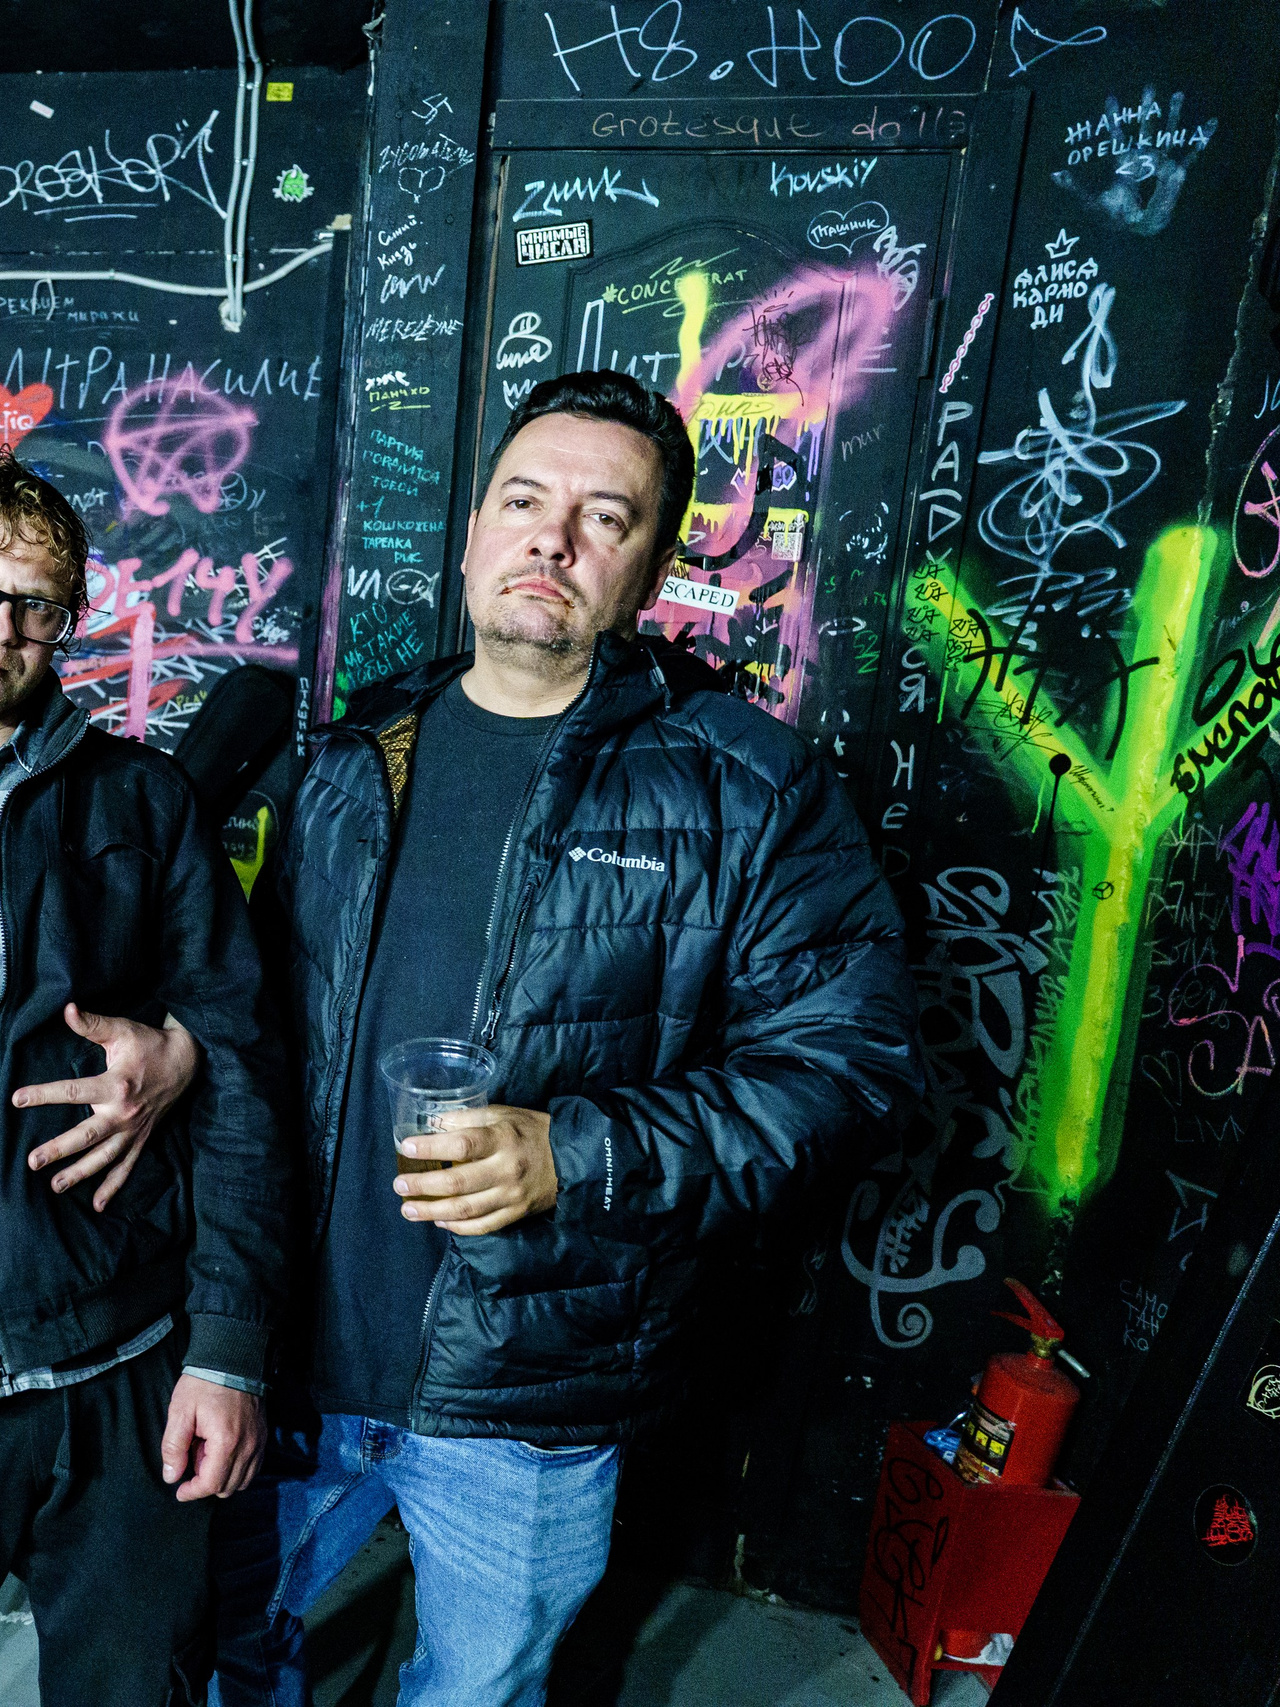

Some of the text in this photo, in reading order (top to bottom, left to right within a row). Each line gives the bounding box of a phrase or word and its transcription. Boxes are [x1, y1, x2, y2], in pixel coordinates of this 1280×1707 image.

[593, 112, 821, 145] Grotesque
[521, 225, 586, 244] МНИМЫЕ
[521, 240, 587, 260] ЧИСЛА
[1016, 257, 1098, 289] АЛИСА
[586, 847, 665, 873] Columbia
[603, 1137, 615, 1212] OMNI-HEAT
